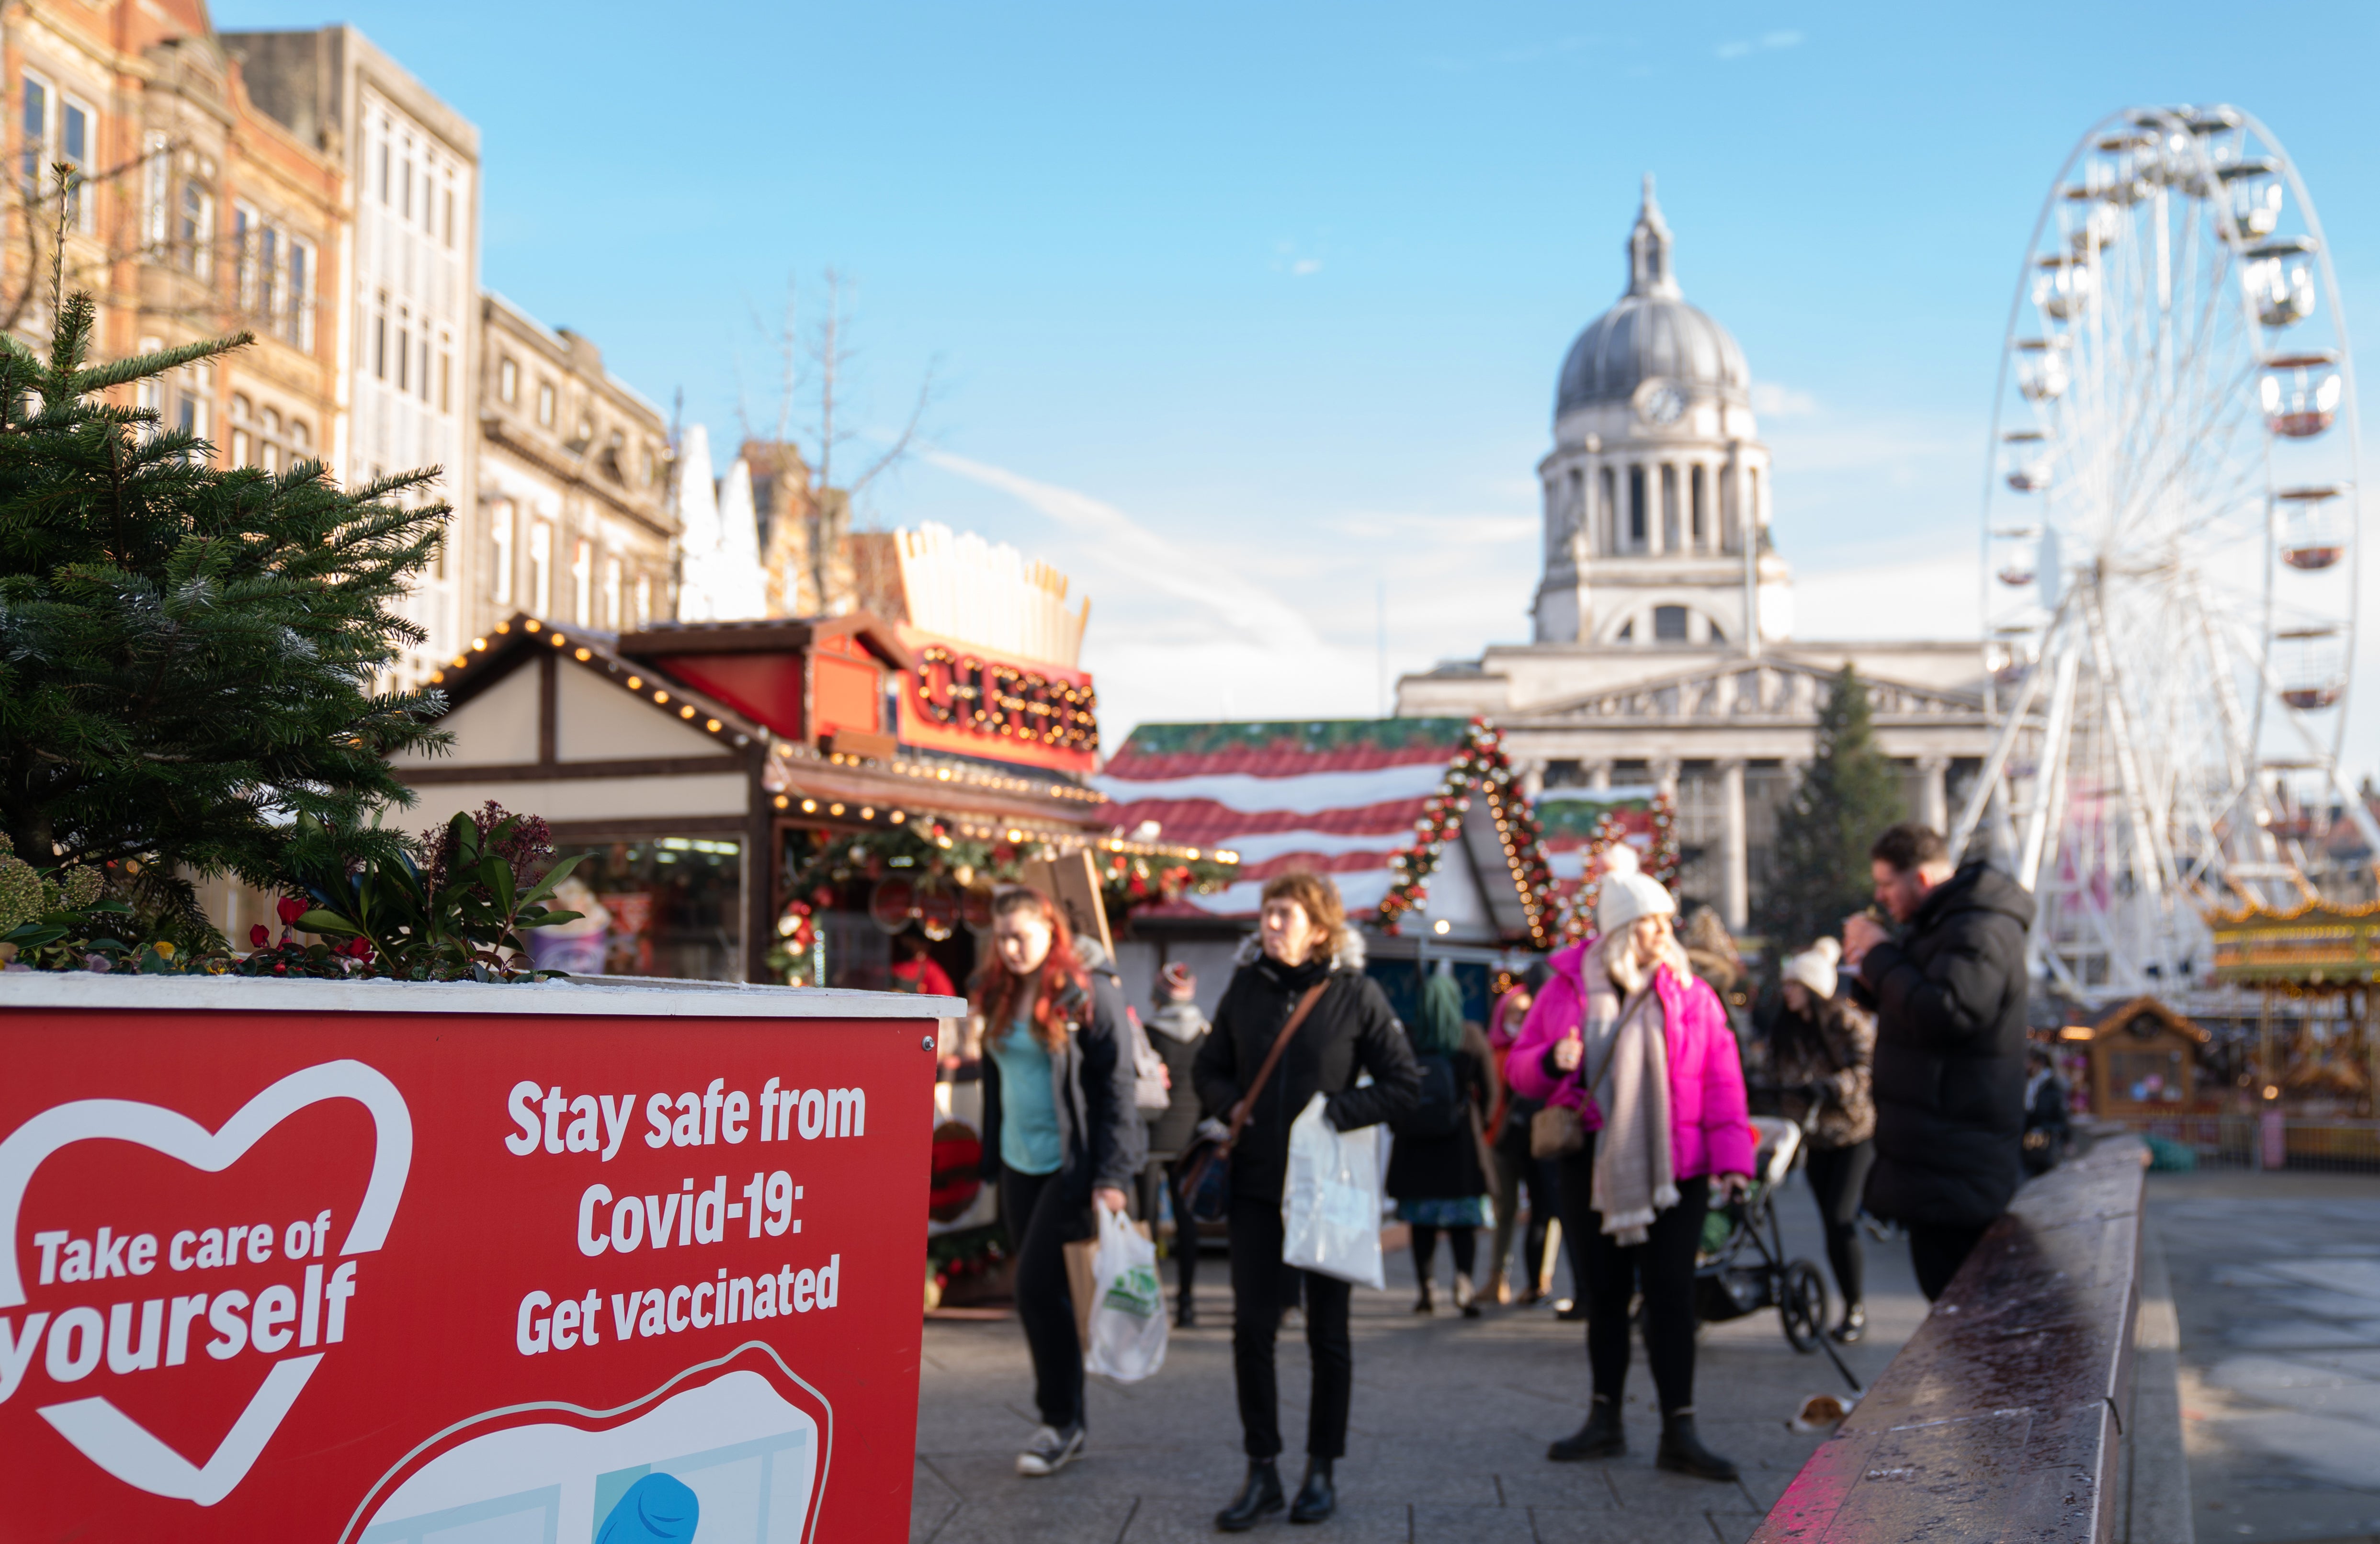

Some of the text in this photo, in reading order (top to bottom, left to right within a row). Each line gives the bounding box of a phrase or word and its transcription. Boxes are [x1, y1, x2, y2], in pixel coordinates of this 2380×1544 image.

[505, 1077, 865, 1162] Stay safe from
[34, 1209, 330, 1285] Take care of
[578, 1171, 803, 1256] Covid-19:
[0, 1261, 356, 1404] yourself
[517, 1254, 839, 1355] Get vaccinated
